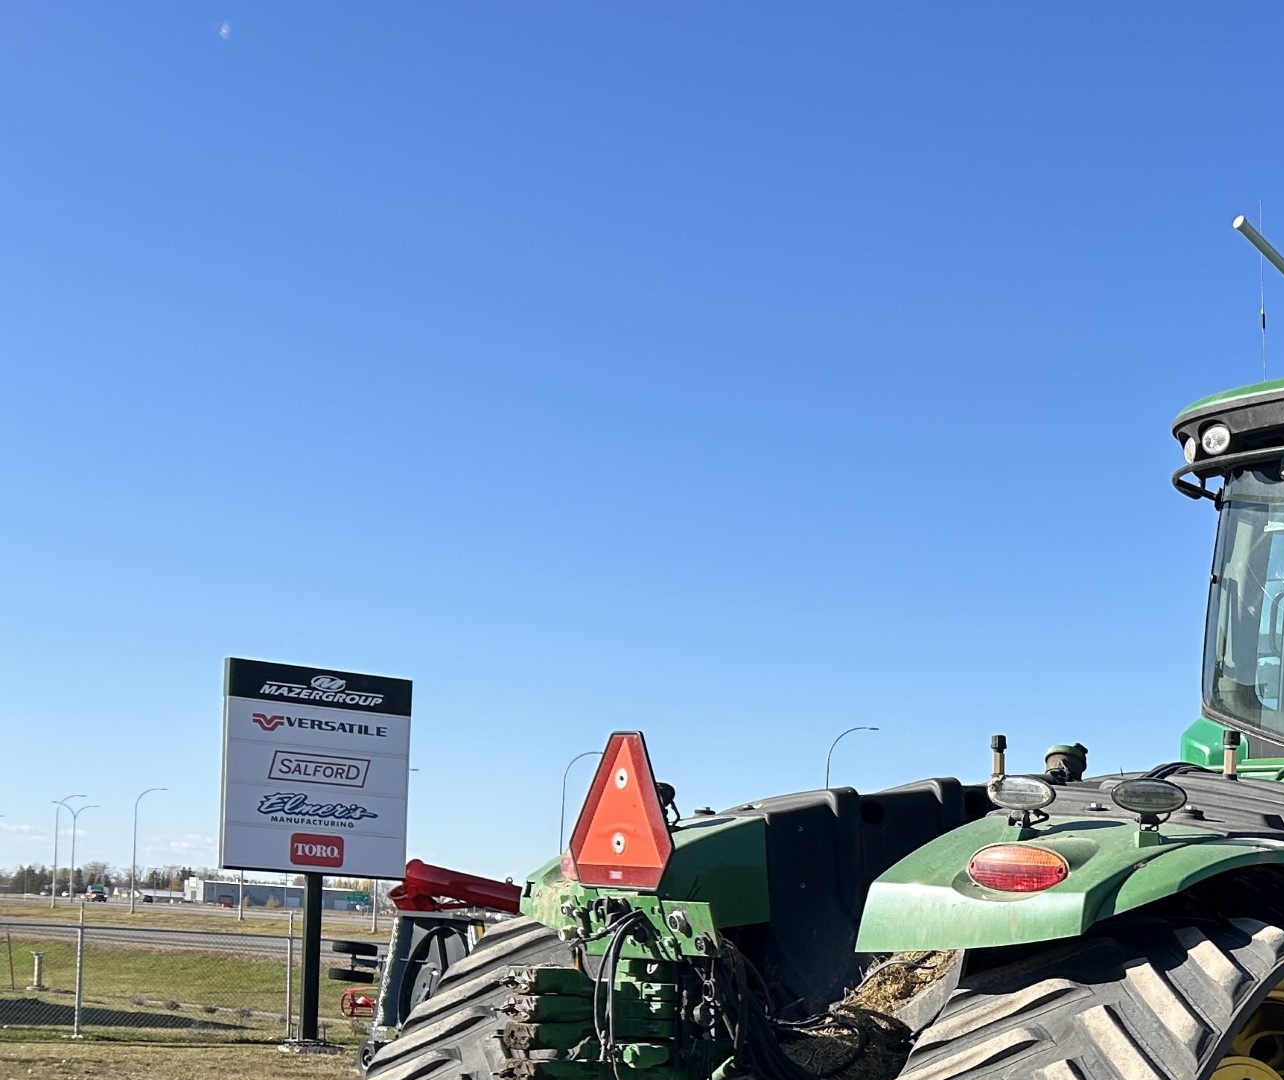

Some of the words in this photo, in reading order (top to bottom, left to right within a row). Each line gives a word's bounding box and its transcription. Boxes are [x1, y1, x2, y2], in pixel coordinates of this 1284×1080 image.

[259, 684, 383, 707] MAZERGROUP
[285, 716, 388, 737] VERSATILE
[278, 758, 360, 781] SALFORD
[257, 792, 378, 820] Elmer's
[270, 815, 355, 828] MANUFACTURING
[294, 842, 340, 858] TORO
